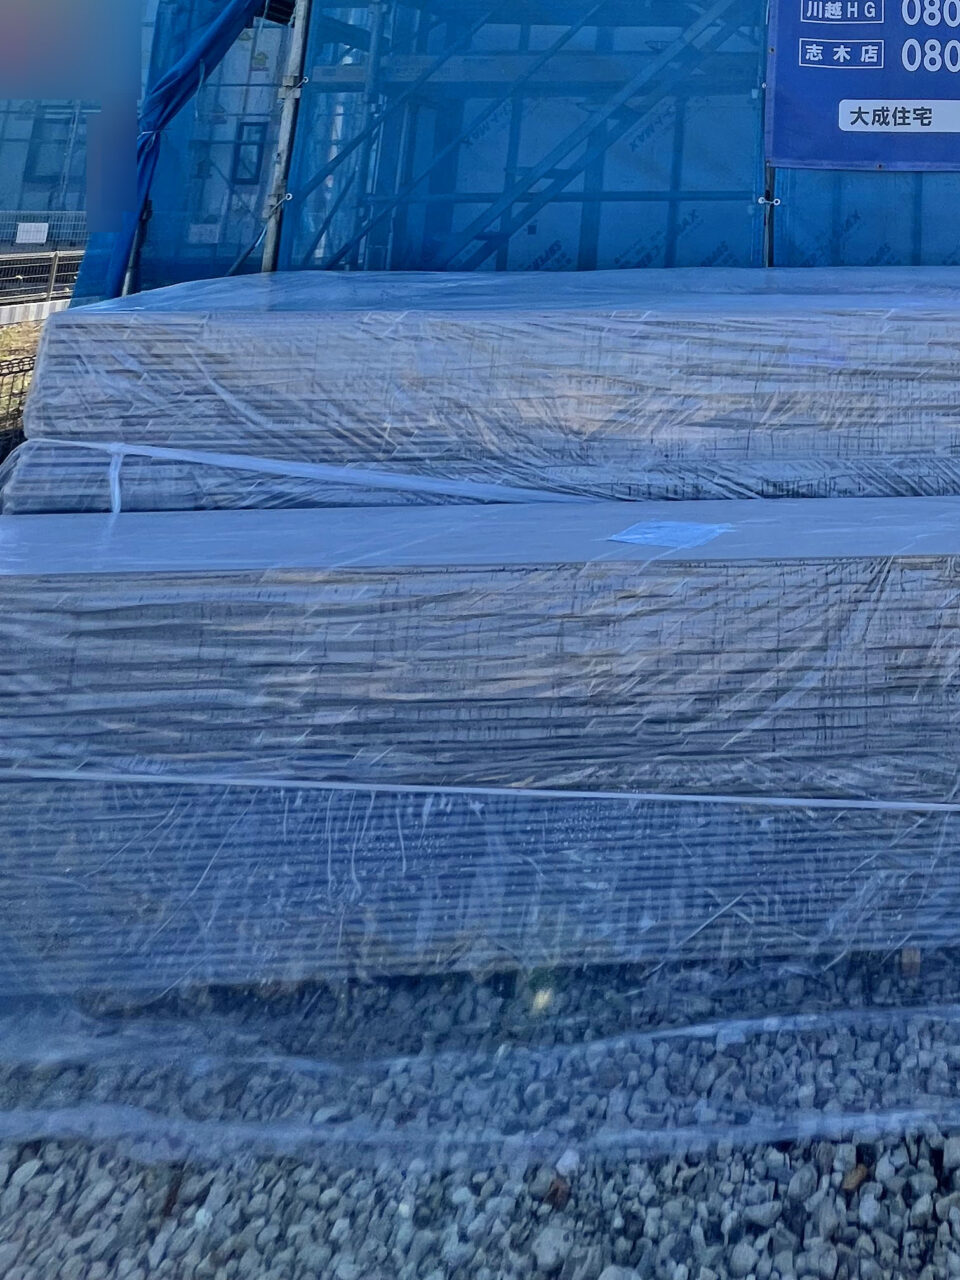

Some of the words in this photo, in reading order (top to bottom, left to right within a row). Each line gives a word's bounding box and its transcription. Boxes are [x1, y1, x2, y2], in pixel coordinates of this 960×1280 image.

[805, 43, 879, 63] 志木店
[849, 106, 933, 127] 大成住宅
